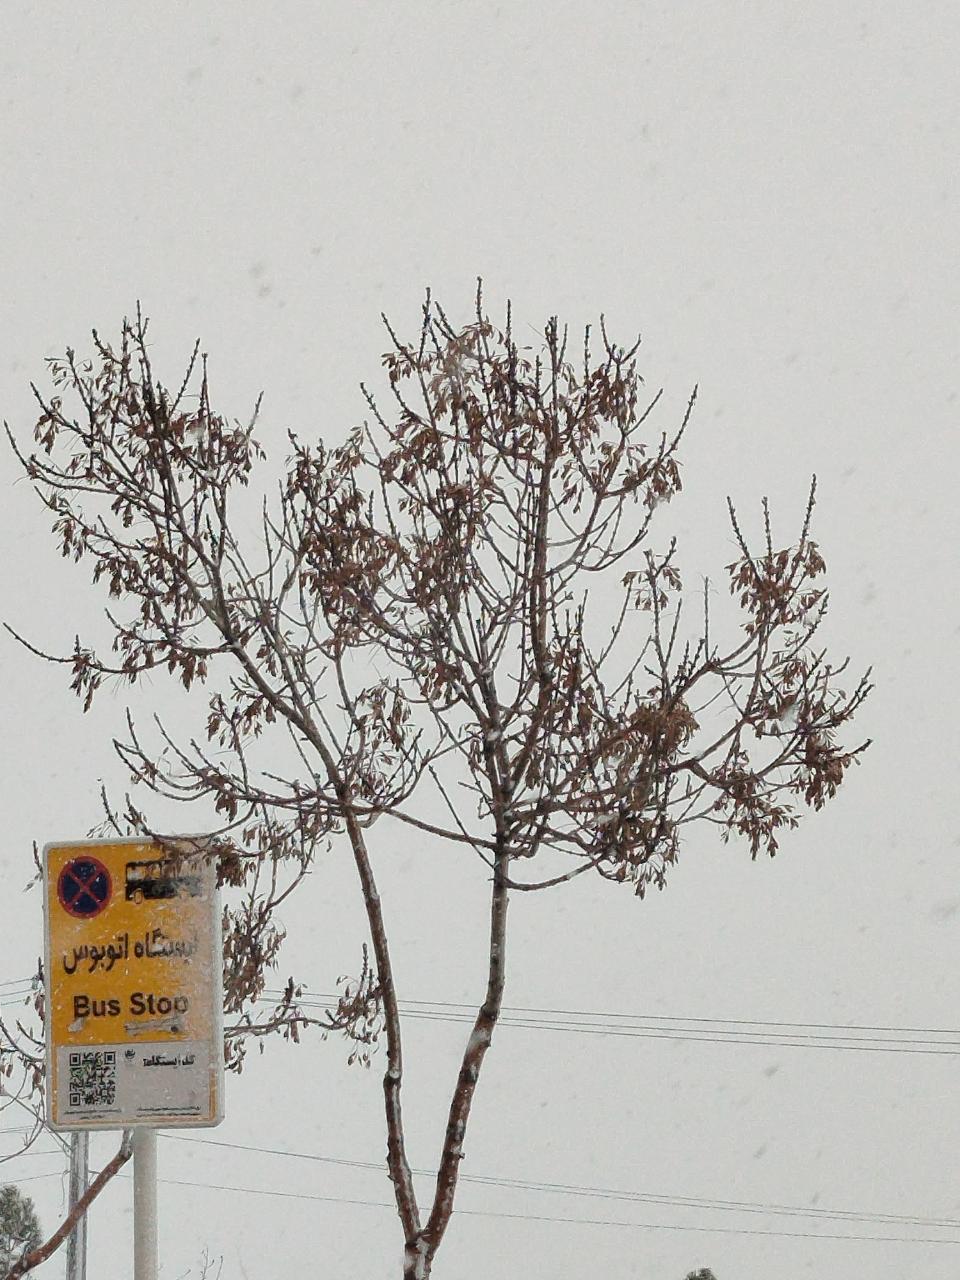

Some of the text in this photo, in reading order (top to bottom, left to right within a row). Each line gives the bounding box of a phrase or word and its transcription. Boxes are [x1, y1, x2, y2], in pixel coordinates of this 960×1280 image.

[63, 932, 129, 974] اتوبوس
[74, 992, 189, 1018] Bus Stop
